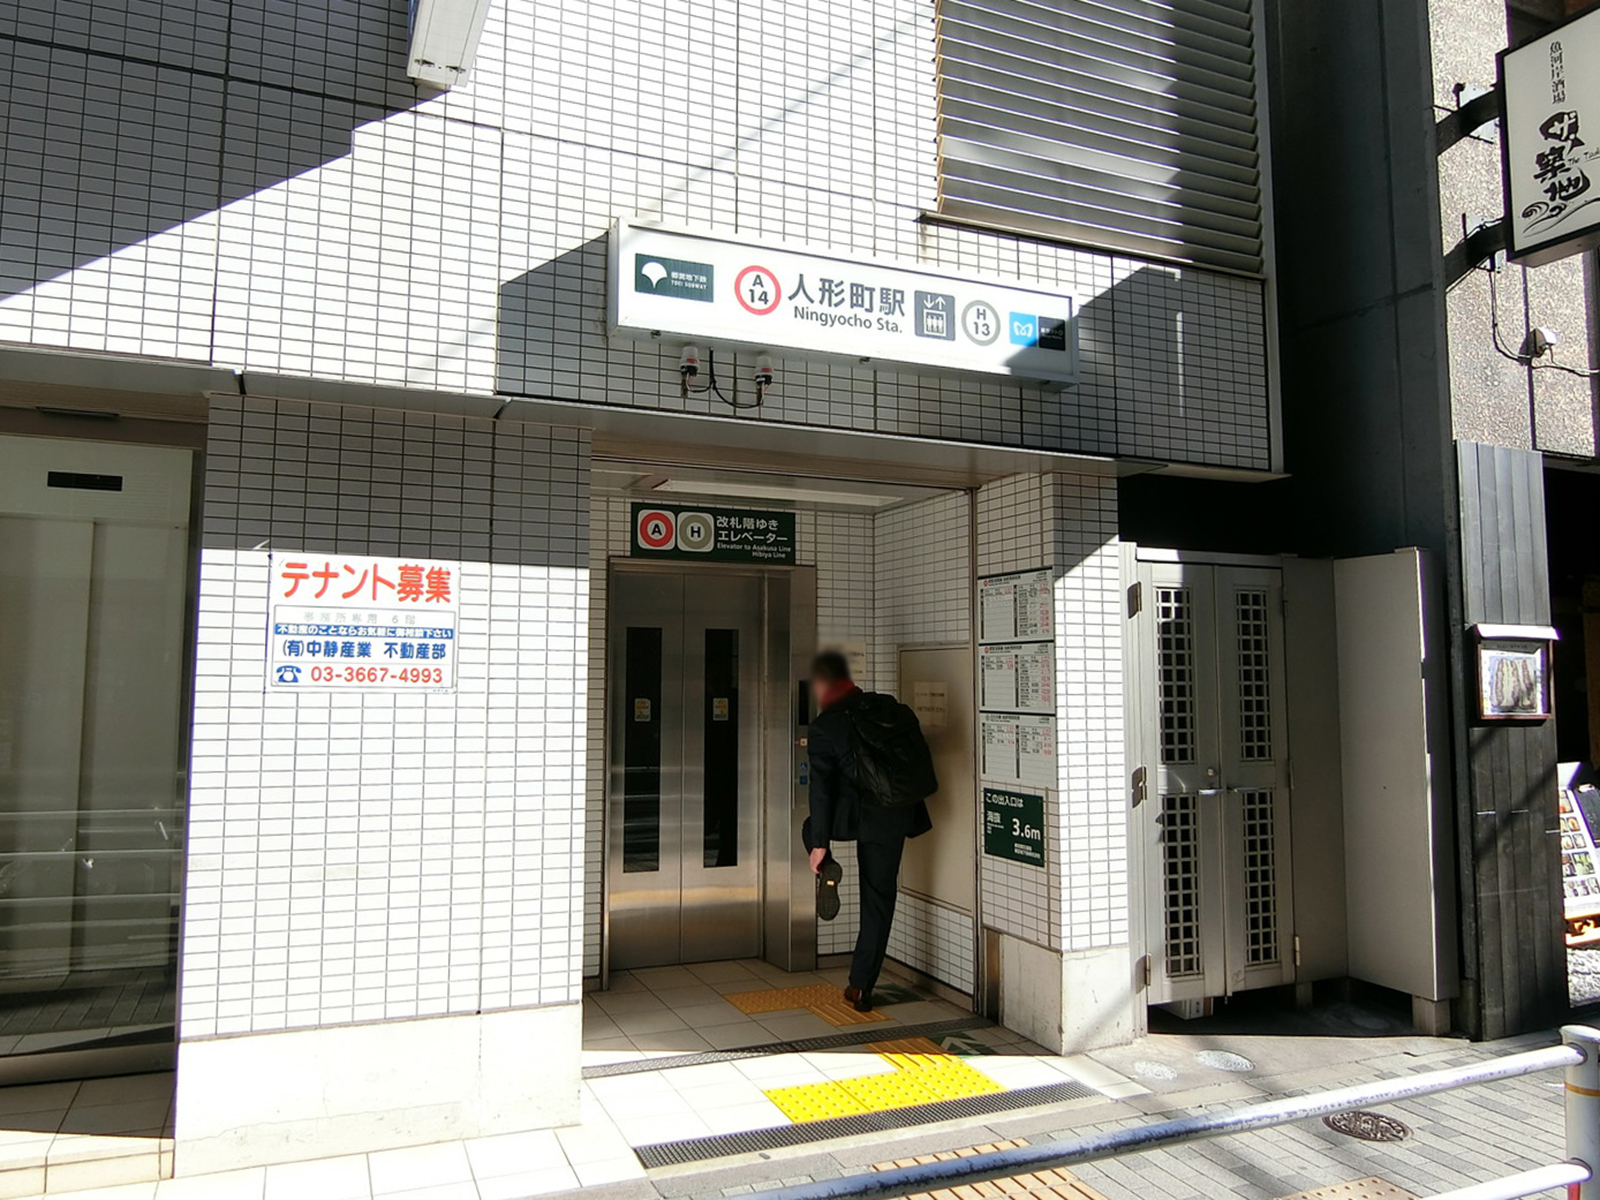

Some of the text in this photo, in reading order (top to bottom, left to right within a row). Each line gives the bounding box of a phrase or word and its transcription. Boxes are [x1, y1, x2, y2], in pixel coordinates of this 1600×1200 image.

[752, 274, 764, 288] A
[749, 289, 769, 305] 14
[788, 273, 905, 317] 人形町駅
[794, 306, 903, 333] Ningyocho Sta.
[977, 308, 986, 321] H
[973, 321, 990, 336] 13
[651, 523, 663, 536] A
[716, 516, 778, 531] 改札階ゆき
[690, 526, 701, 538] H
[717, 530, 788, 543] エレベーター
[717, 542, 743, 550] Elevator
[752, 544, 777, 552] Asakusa
[778, 545, 791, 553] Line
[752, 551, 772, 559] Hibiya
[281, 562, 451, 603] テナント募集
[384, 641, 446, 659] 不動産部
[311, 665, 443, 684] 03-3667-4993
[1012, 817, 1041, 840] 3.6m
